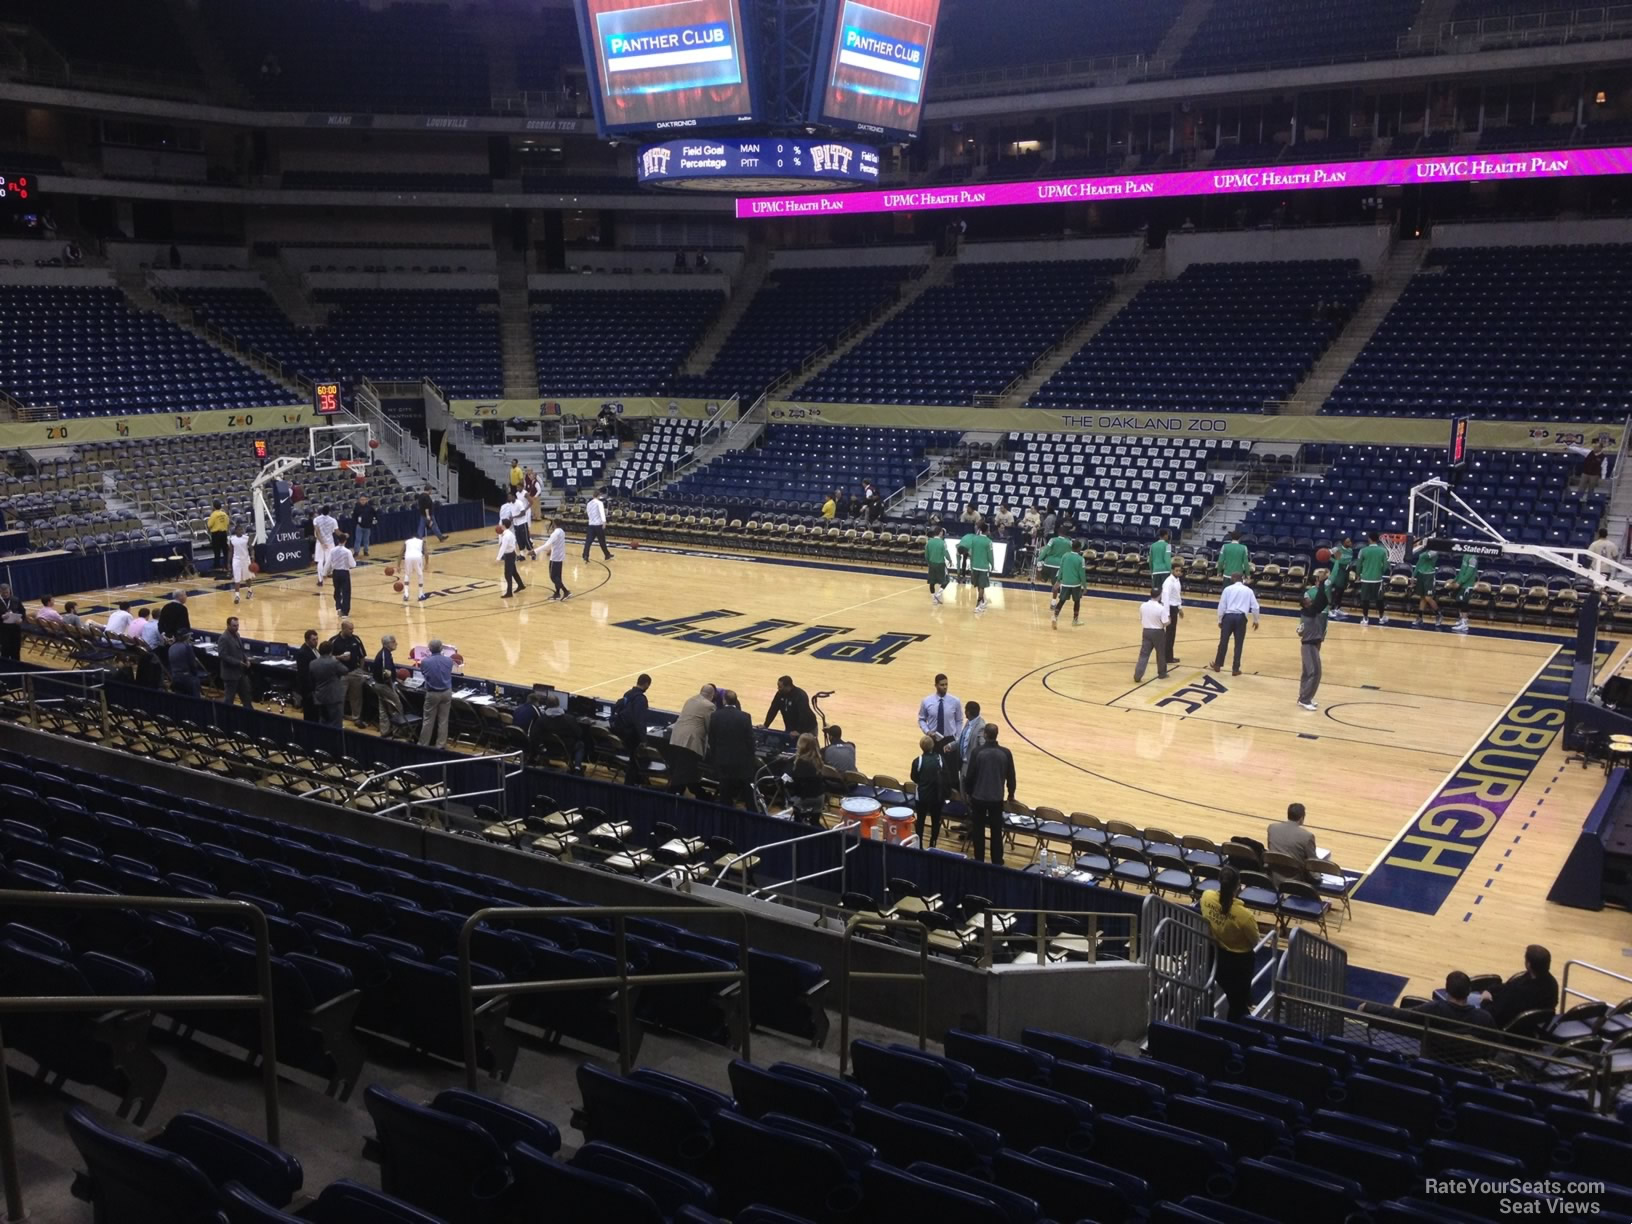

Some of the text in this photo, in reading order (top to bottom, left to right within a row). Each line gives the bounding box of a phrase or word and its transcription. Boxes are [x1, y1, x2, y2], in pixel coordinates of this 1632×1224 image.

[611, 28, 724, 54] PANTHER CLUB
[846, 31, 920, 63] PANTHER CLUB
[426, 118, 468, 128] LOUISVILLE
[558, 121, 576, 130] TECH
[656, 119, 697, 129] DAKTRONICS
[683, 145, 724, 157] Field Goal
[740, 144, 760, 153] MAN
[777, 144, 784, 153] 0
[680, 158, 727, 170] Percentage
[740, 158, 759, 167] PITT
[777, 159, 784, 168] 0
[810, 144, 853, 173] PITT
[1416, 157, 1569, 177] UPMC HEALTH PLAN
[1213, 169, 1346, 188] UPMC HEALTH PLAN
[1038, 181, 1154, 198] UPMC HEALTH PLAN
[752, 199, 843, 214] UPMC HEALTH PLAN
[883, 191, 985, 207] UPMC HEALTH PLAN
[317, 385, 337, 395] 60:00
[321, 394, 336, 410] 35
[1062, 415, 1227, 432] THE OAKLAND ZOO
[276, 531, 301, 542] UPMC
[285, 550, 302, 560] PNC
[609, 608, 931, 665] PITT
[1155, 674, 1229, 714] ACC
